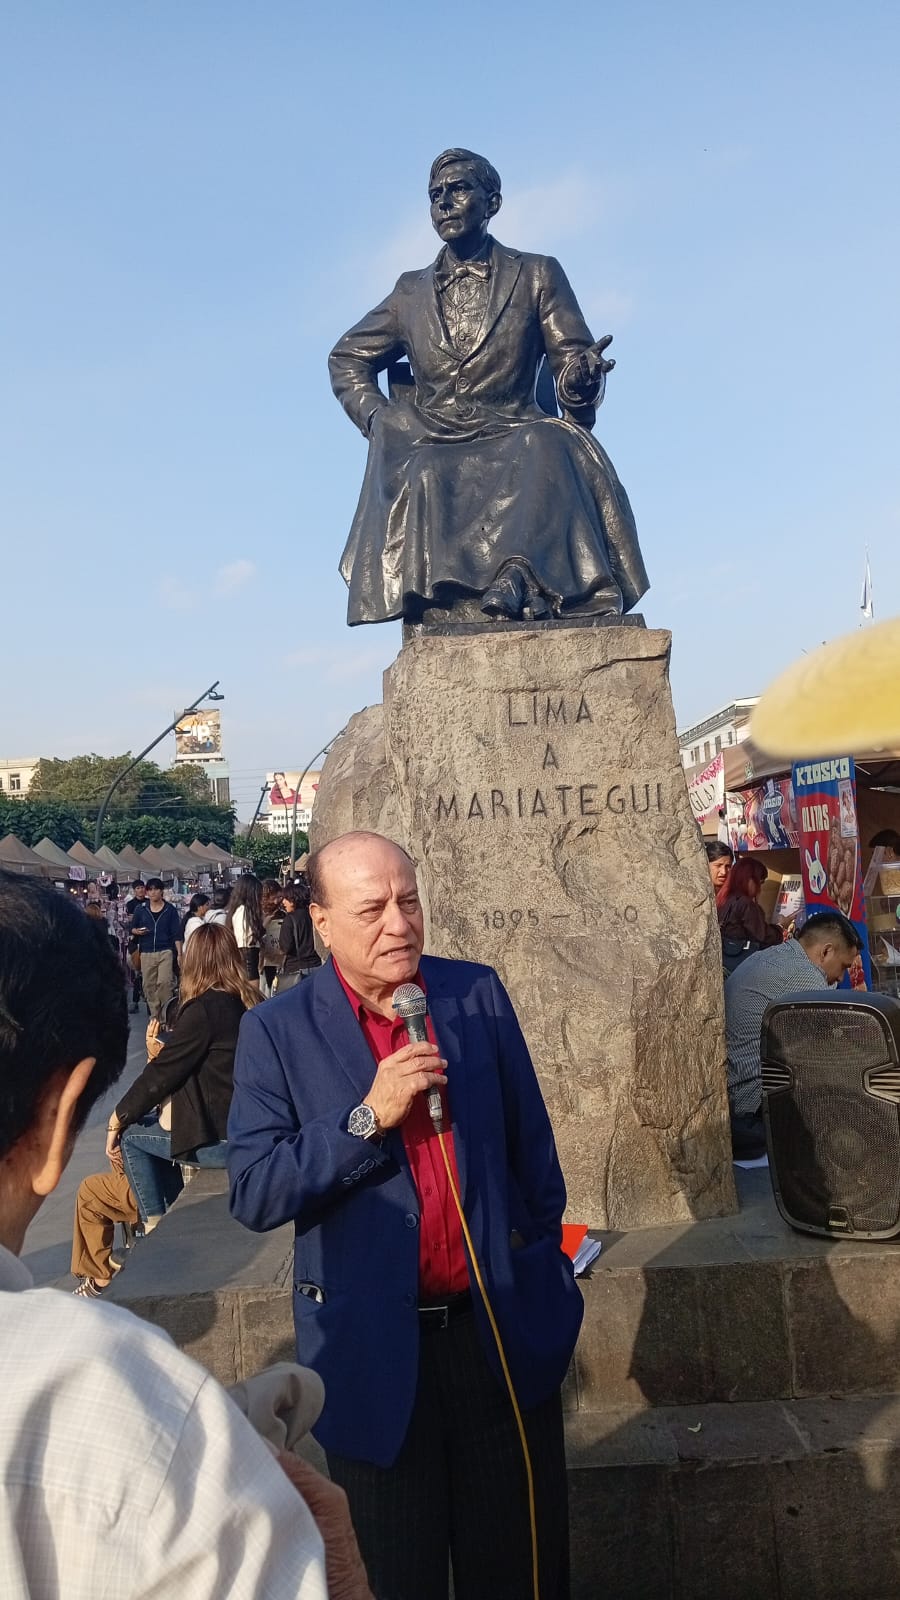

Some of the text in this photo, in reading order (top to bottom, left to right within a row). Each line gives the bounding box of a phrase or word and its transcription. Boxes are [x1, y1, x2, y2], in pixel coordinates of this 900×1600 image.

[508, 694, 594, 727] LIMA
[542, 742, 560, 770] A
[795, 757, 850, 787] KIOSKO
[436, 783, 662, 822] MARIATEGUI
[483, 908, 539, 930] 1895
